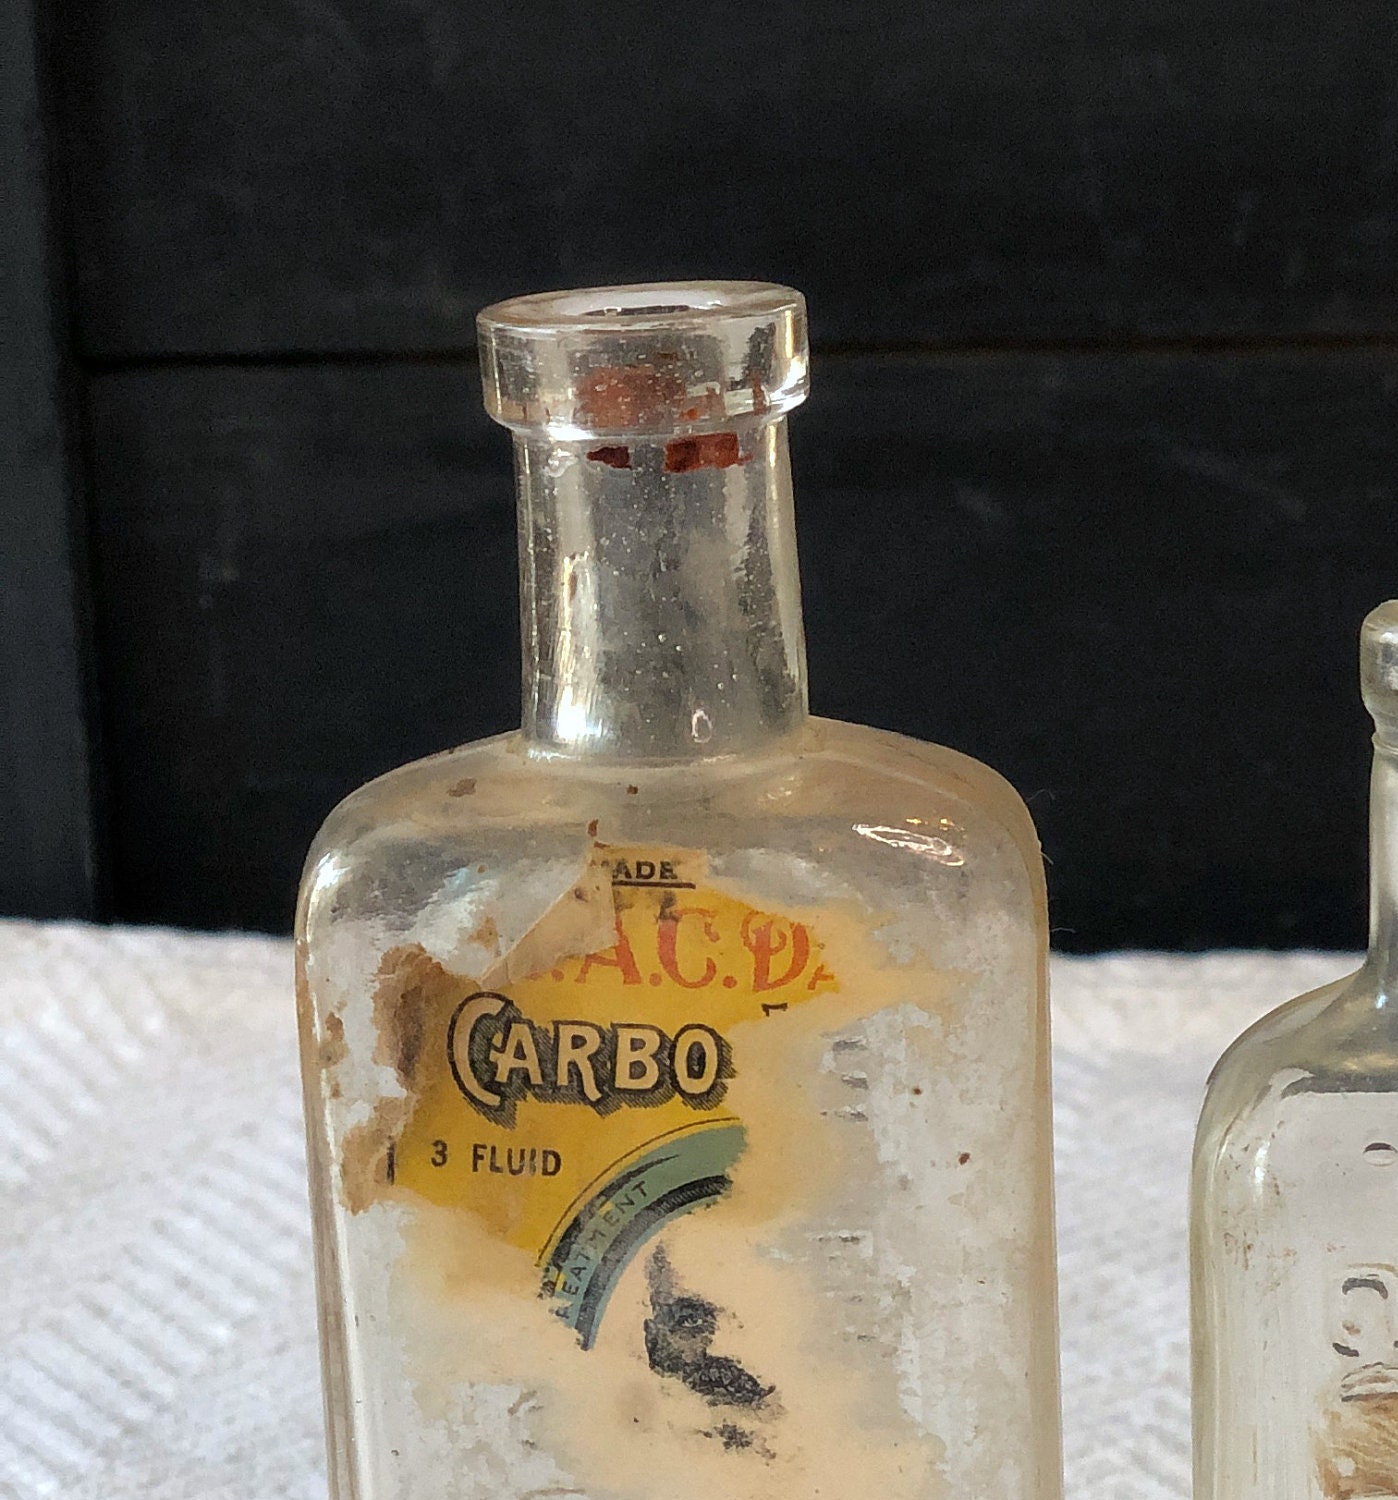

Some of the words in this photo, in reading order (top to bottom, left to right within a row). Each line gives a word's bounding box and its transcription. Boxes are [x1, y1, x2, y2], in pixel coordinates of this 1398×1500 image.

[612, 860, 678, 881] ADE
[448, 991, 735, 1129] CARBO
[430, 1140, 448, 1168] 3
[471, 1144, 562, 1177] FLUID
